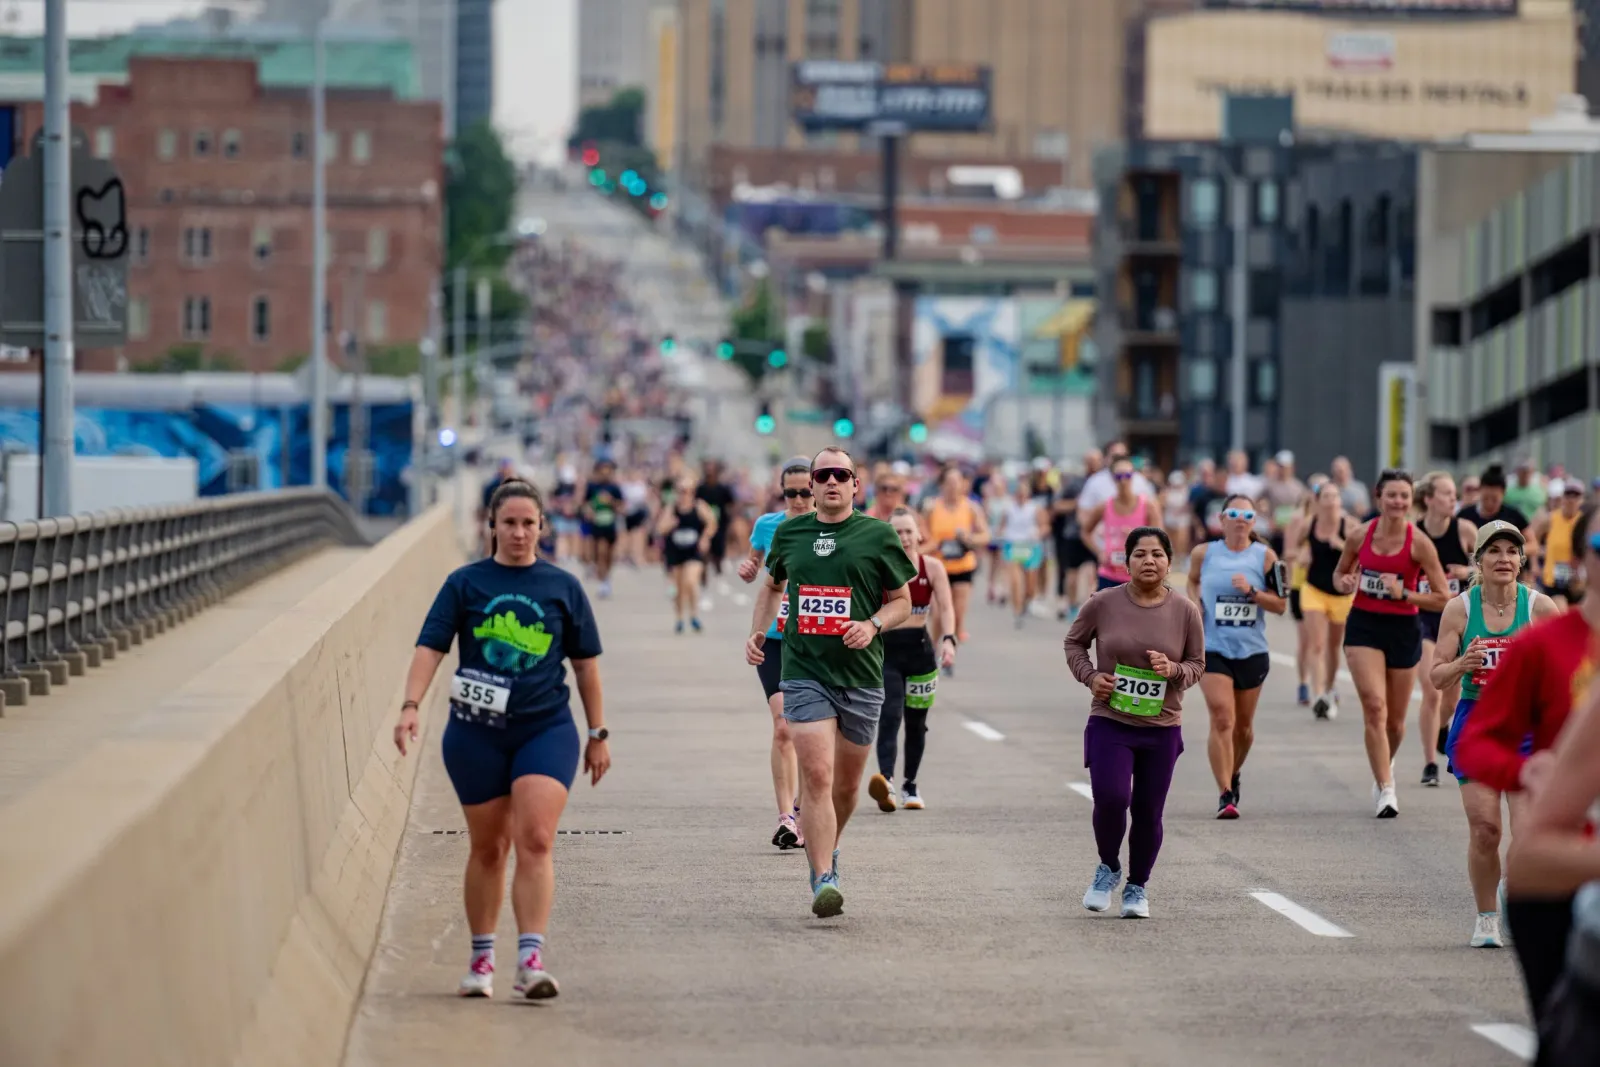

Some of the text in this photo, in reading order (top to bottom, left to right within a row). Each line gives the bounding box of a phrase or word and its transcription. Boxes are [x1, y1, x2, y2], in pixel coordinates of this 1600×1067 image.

[801, 598, 846, 614] 4256
[1223, 605, 1250, 617] 879
[460, 681, 495, 705] 355
[1116, 677, 1161, 697] 2103
